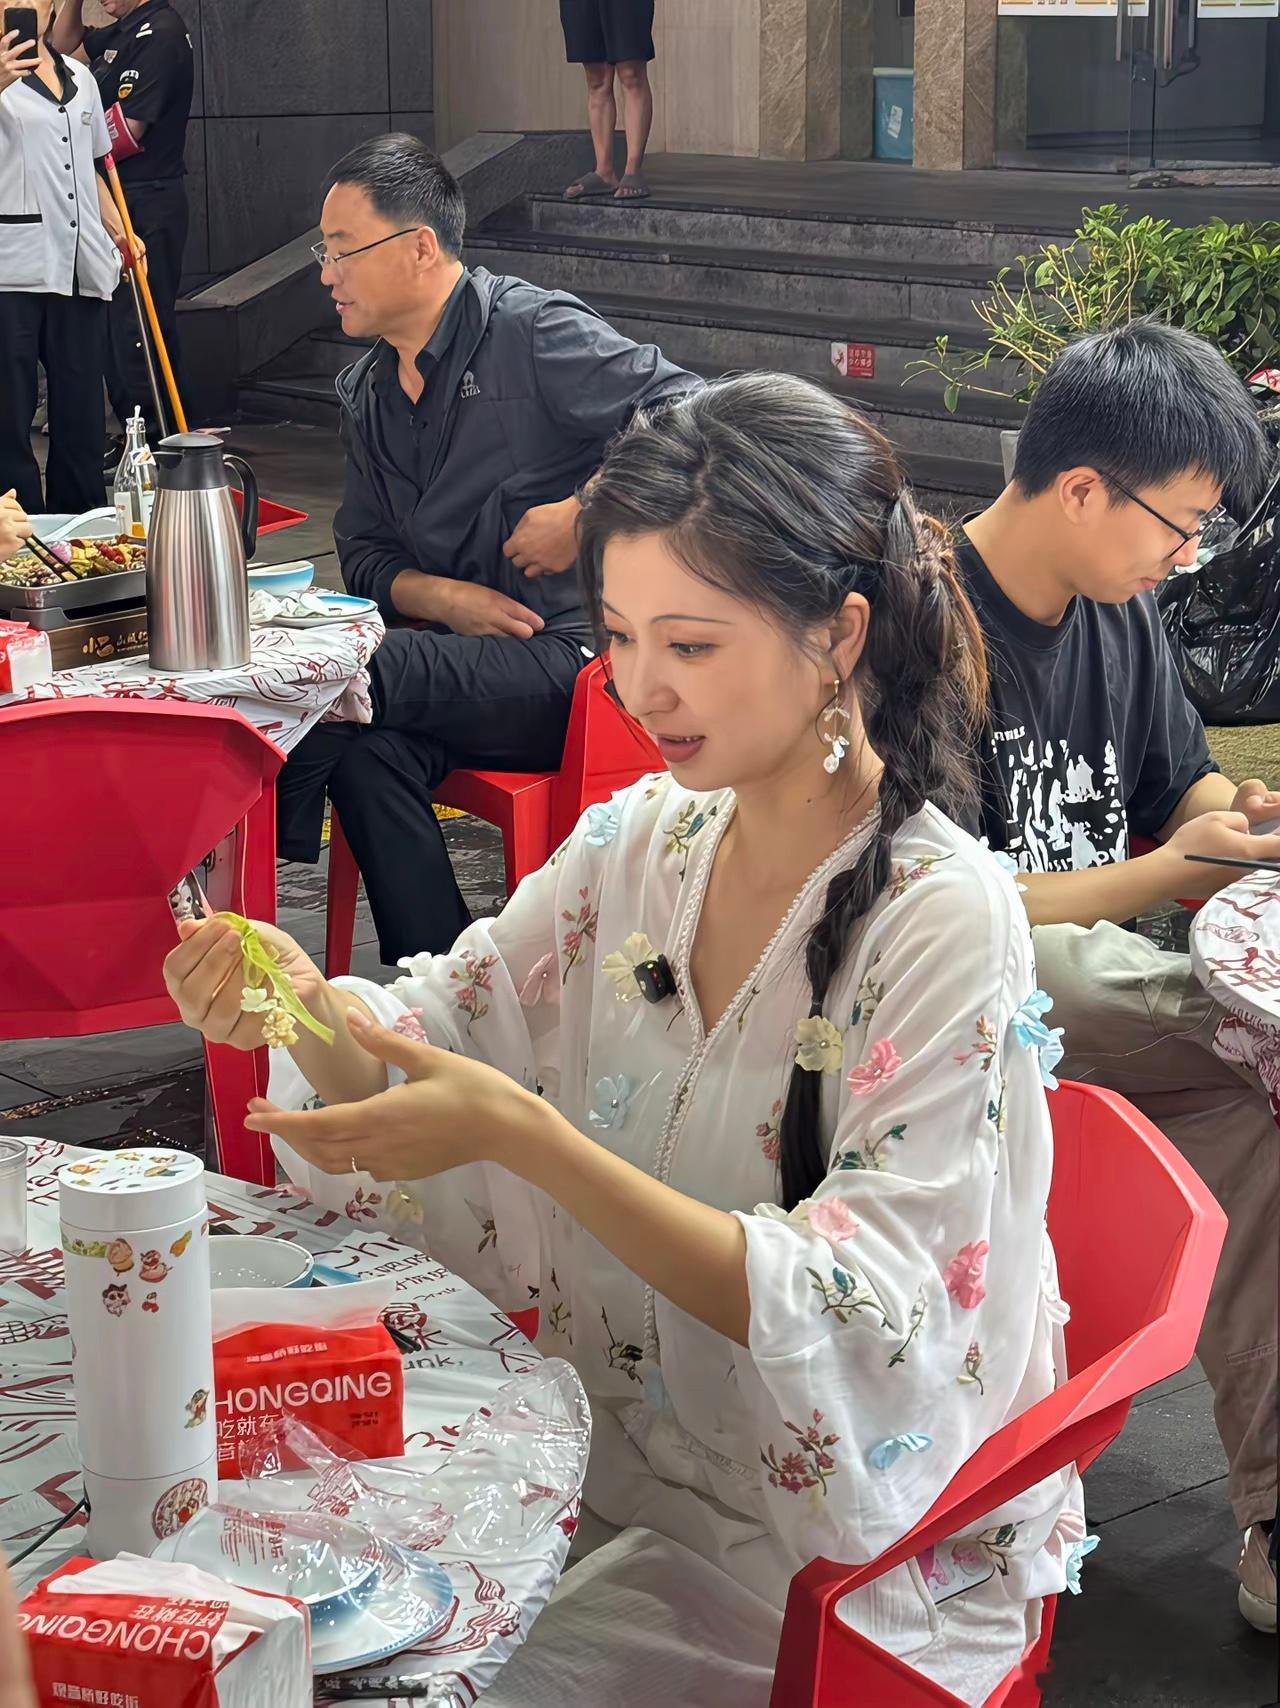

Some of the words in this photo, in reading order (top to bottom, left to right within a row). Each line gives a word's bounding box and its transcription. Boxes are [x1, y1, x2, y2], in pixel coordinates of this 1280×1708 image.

[215, 1371, 392, 1415] HONGQING
[215, 1414, 280, 1440] 吃就在
[128, 1604, 227, 1629] 好吃就在
